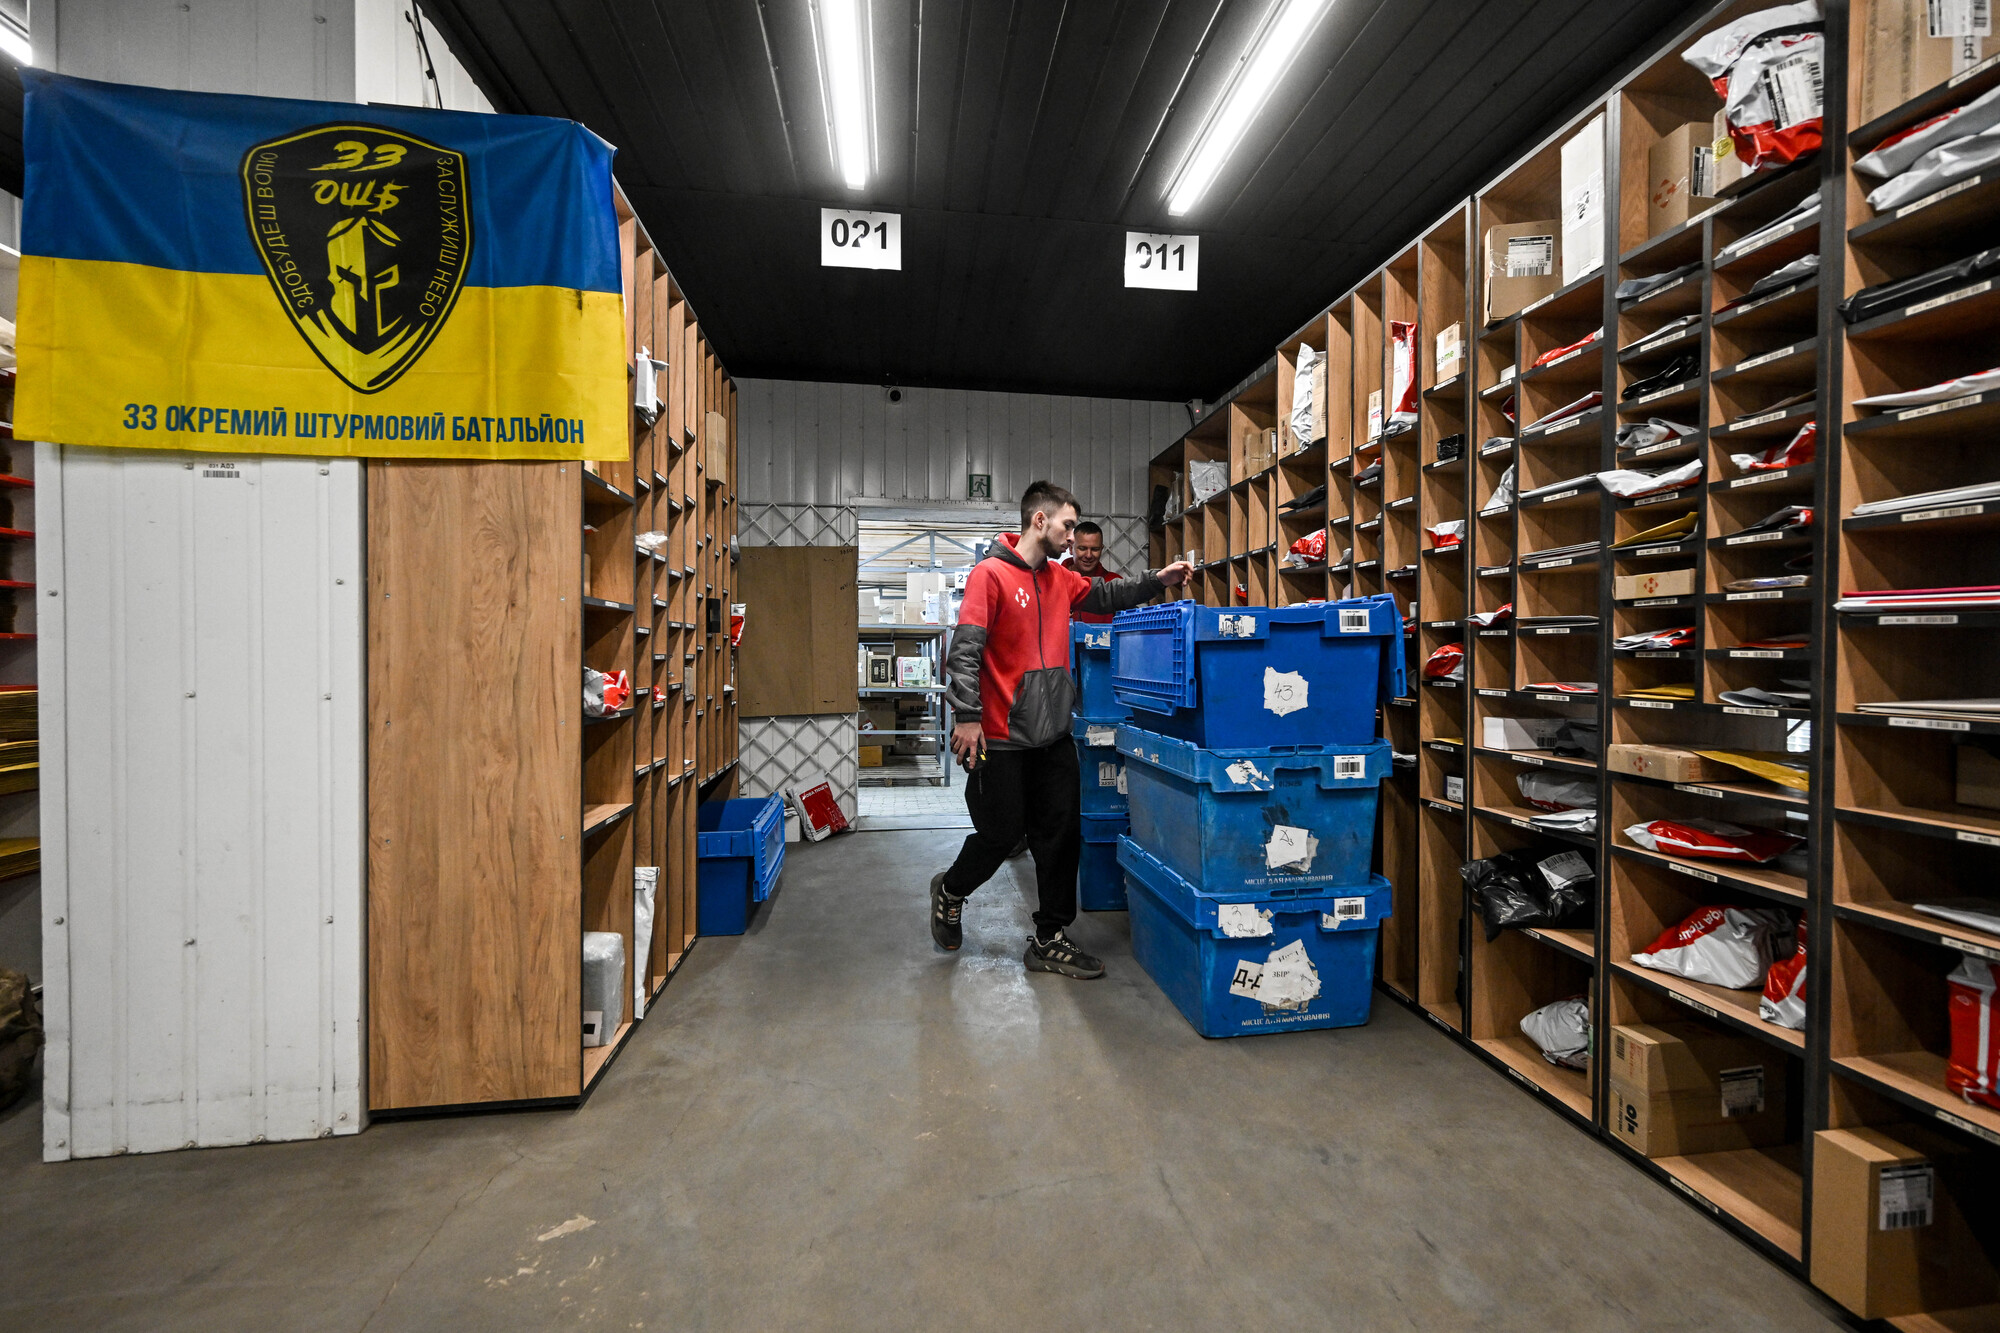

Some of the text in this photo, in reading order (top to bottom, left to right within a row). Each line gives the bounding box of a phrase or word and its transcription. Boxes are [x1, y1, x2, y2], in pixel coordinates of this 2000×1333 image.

[307, 140, 408, 172] 33
[255, 152, 314, 309] ЗДОБУДЕШ ВОЛЮ
[420, 157, 460, 316] ЗАСЛУЖИШ НЕБО
[831, 218, 888, 250] 021
[123, 403, 585, 444] 33 ОКРЕМИЙ ШТУРМОВИЙ БАТАЛЬЙОН
[1274, 682, 1293, 701] 43
